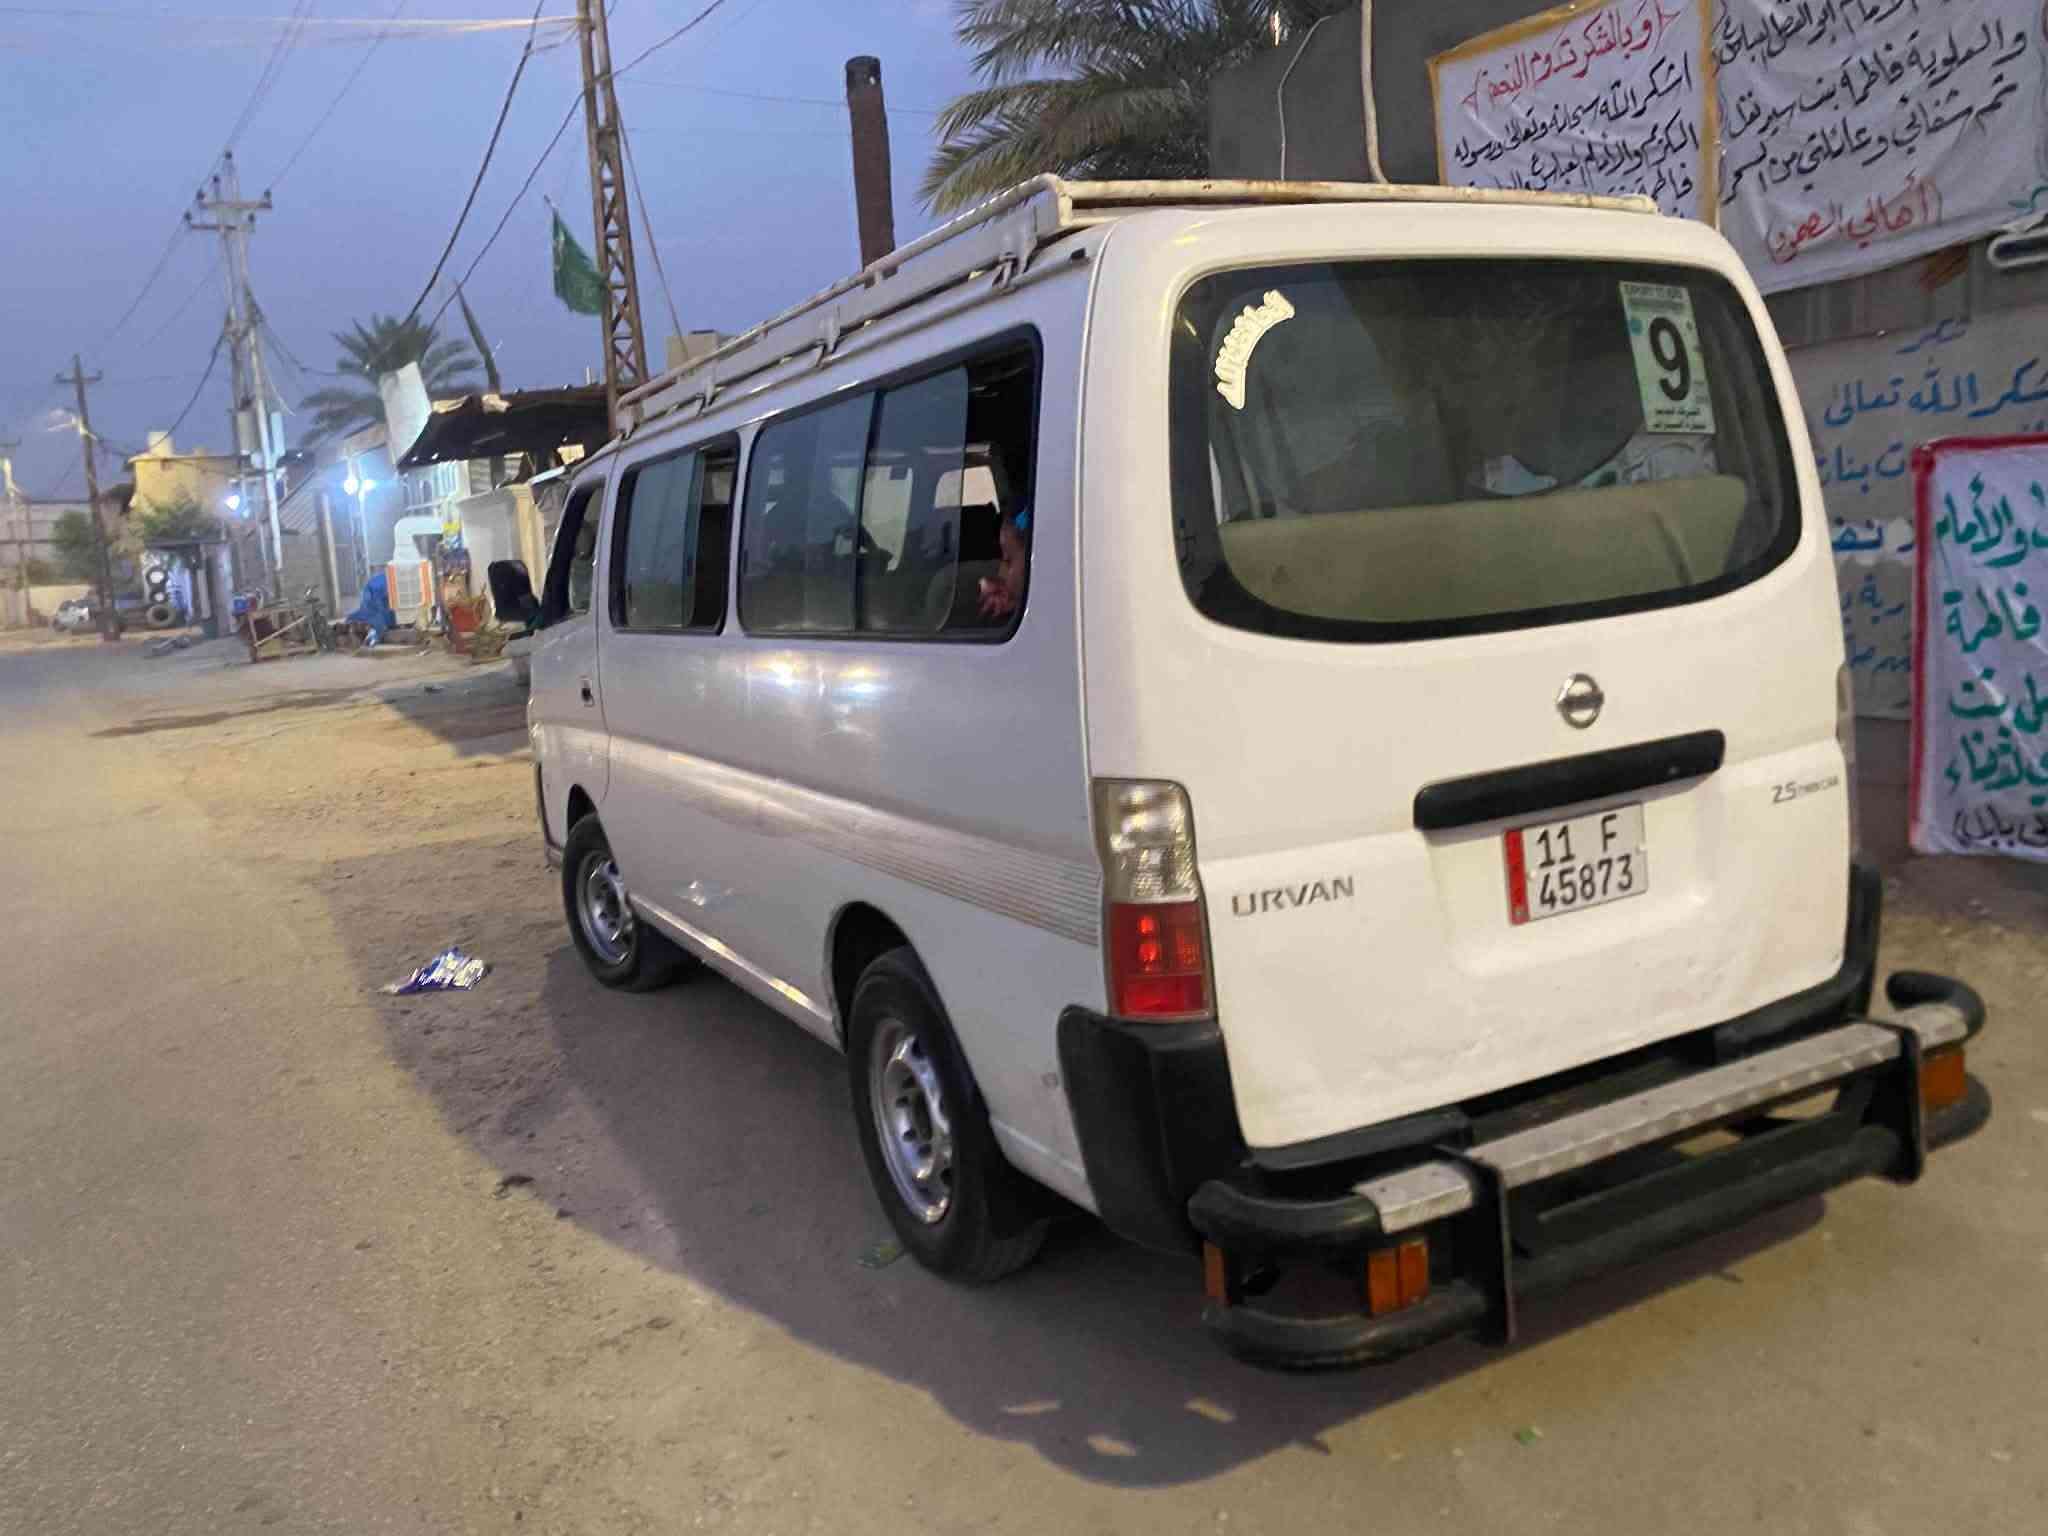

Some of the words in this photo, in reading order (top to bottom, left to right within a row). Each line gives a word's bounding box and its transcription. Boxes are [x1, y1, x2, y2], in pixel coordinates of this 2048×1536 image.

[1600, 79, 1637, 121] الله
[1634, 161, 1693, 200] فاطة
[1649, 316, 1691, 402] 9
[1908, 358, 1977, 414] الله
[1824, 377, 1904, 427] تعالى
[1943, 581, 2042, 653] فاطمة
[1537, 825, 1576, 868] 11
[1601, 813, 1618, 852] F
[1231, 876, 1355, 917] URVAN
[1540, 853, 1633, 909] 45873
